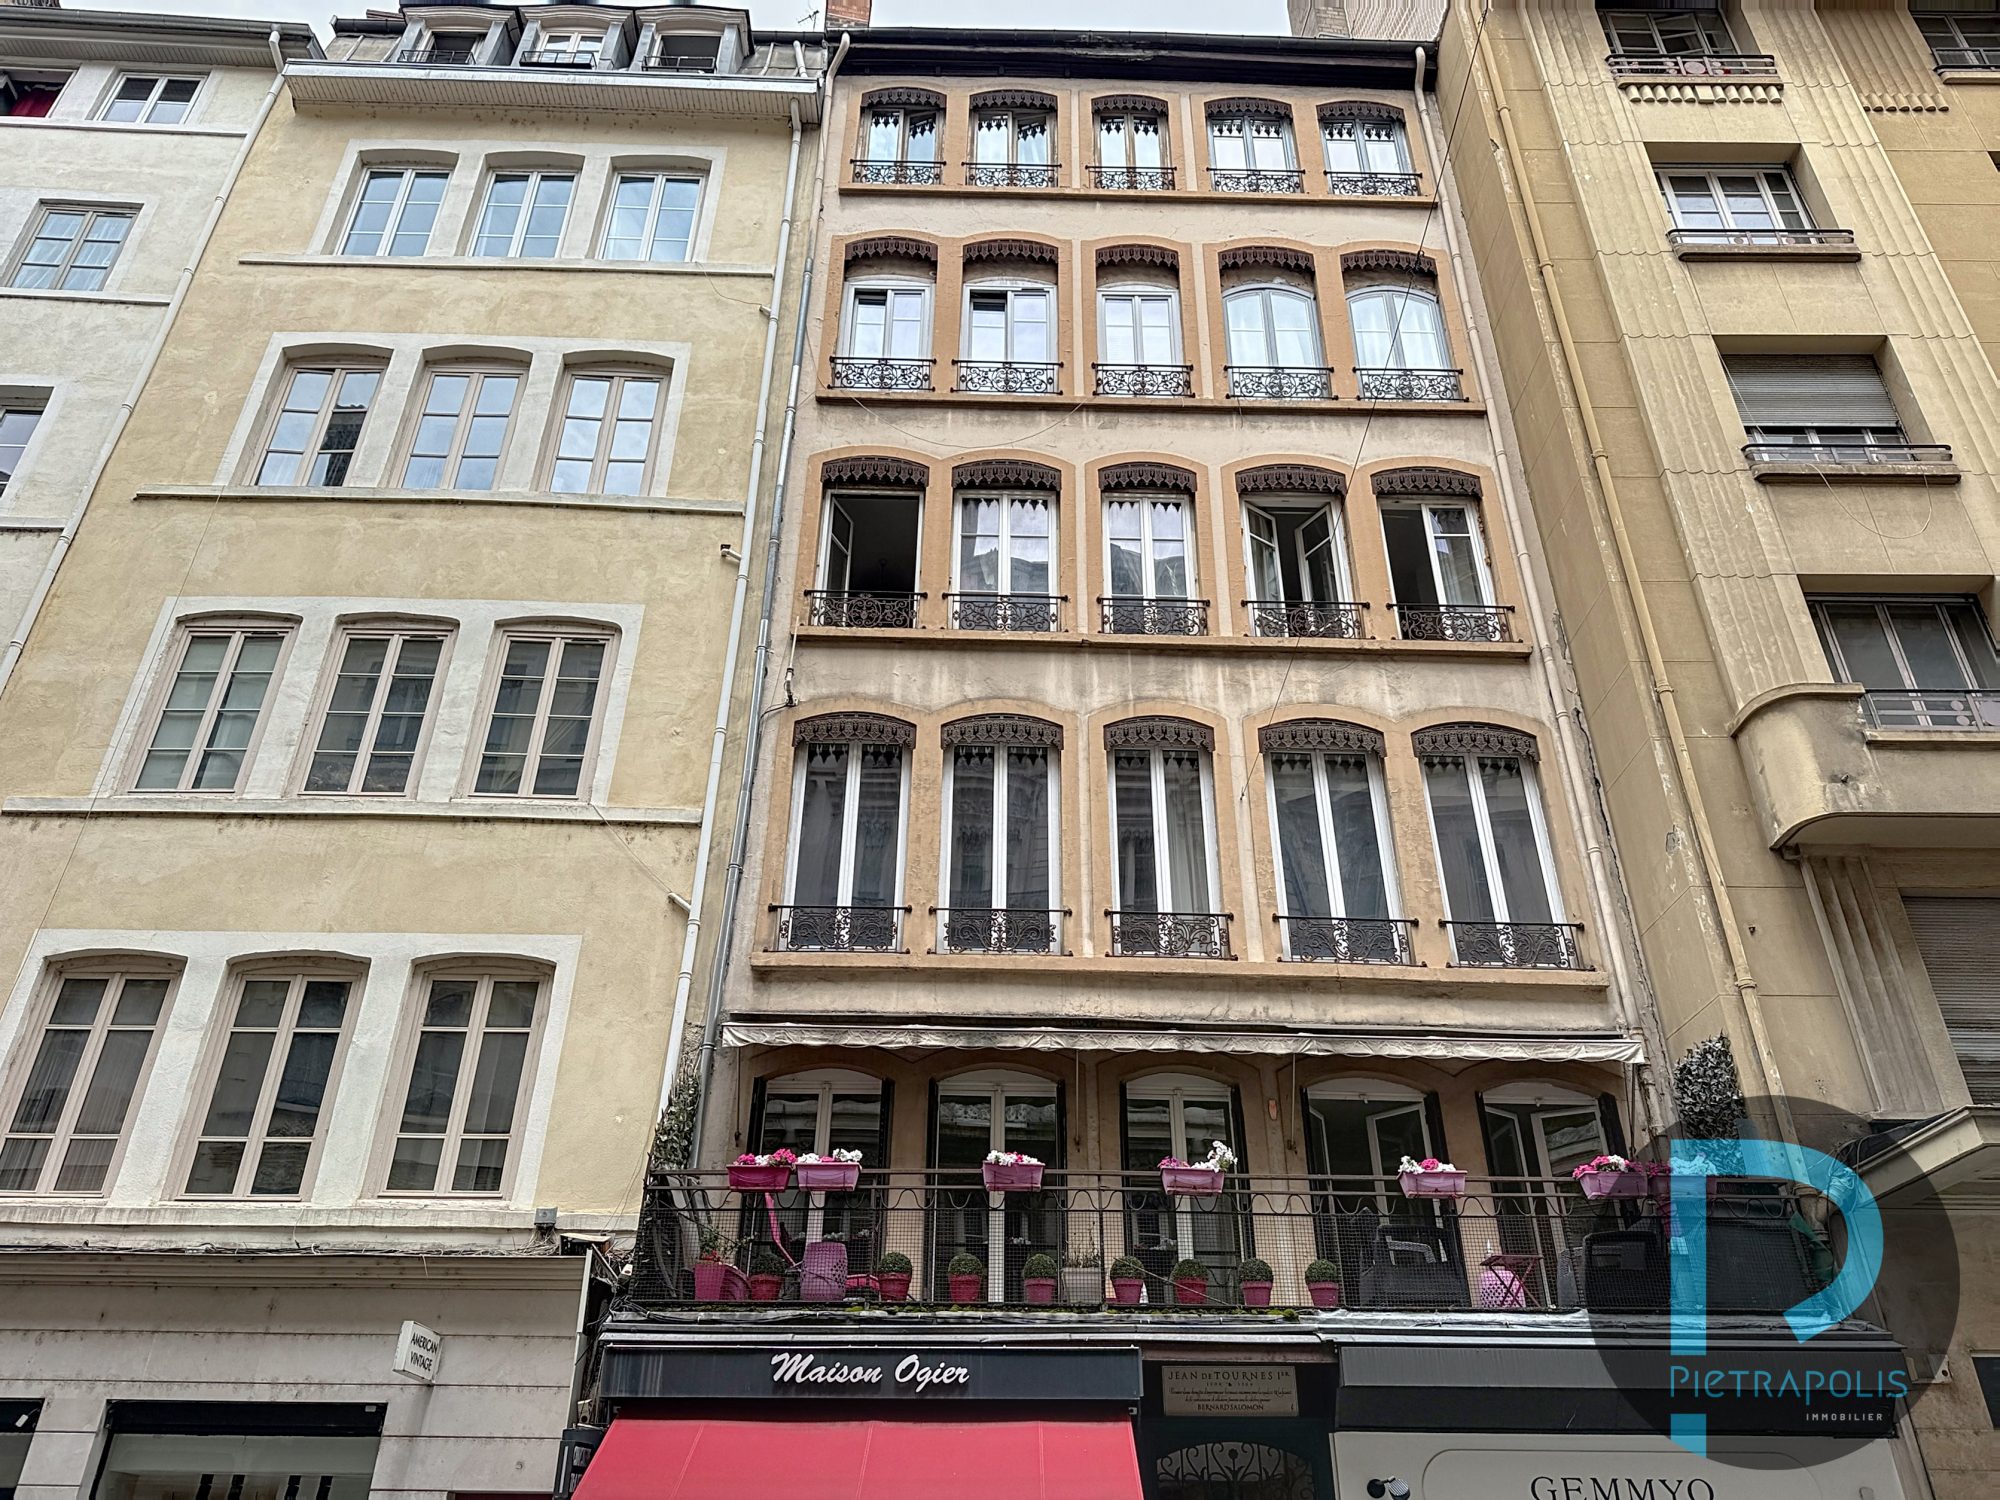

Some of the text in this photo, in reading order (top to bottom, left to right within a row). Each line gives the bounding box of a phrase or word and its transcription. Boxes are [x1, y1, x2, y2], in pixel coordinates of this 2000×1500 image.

[411, 1332, 438, 1355] AMERICAN
[410, 1351, 433, 1371] VINTAGE
[771, 1352, 969, 1392] Maison Ogier
[1168, 1371, 1198, 1380] JEAN
[1213, 1371, 1273, 1381] TOURNES
[1197, 1403, 1264, 1411] BERNARD SALOMON
[1530, 1476, 1715, 1500] GEMMYO
